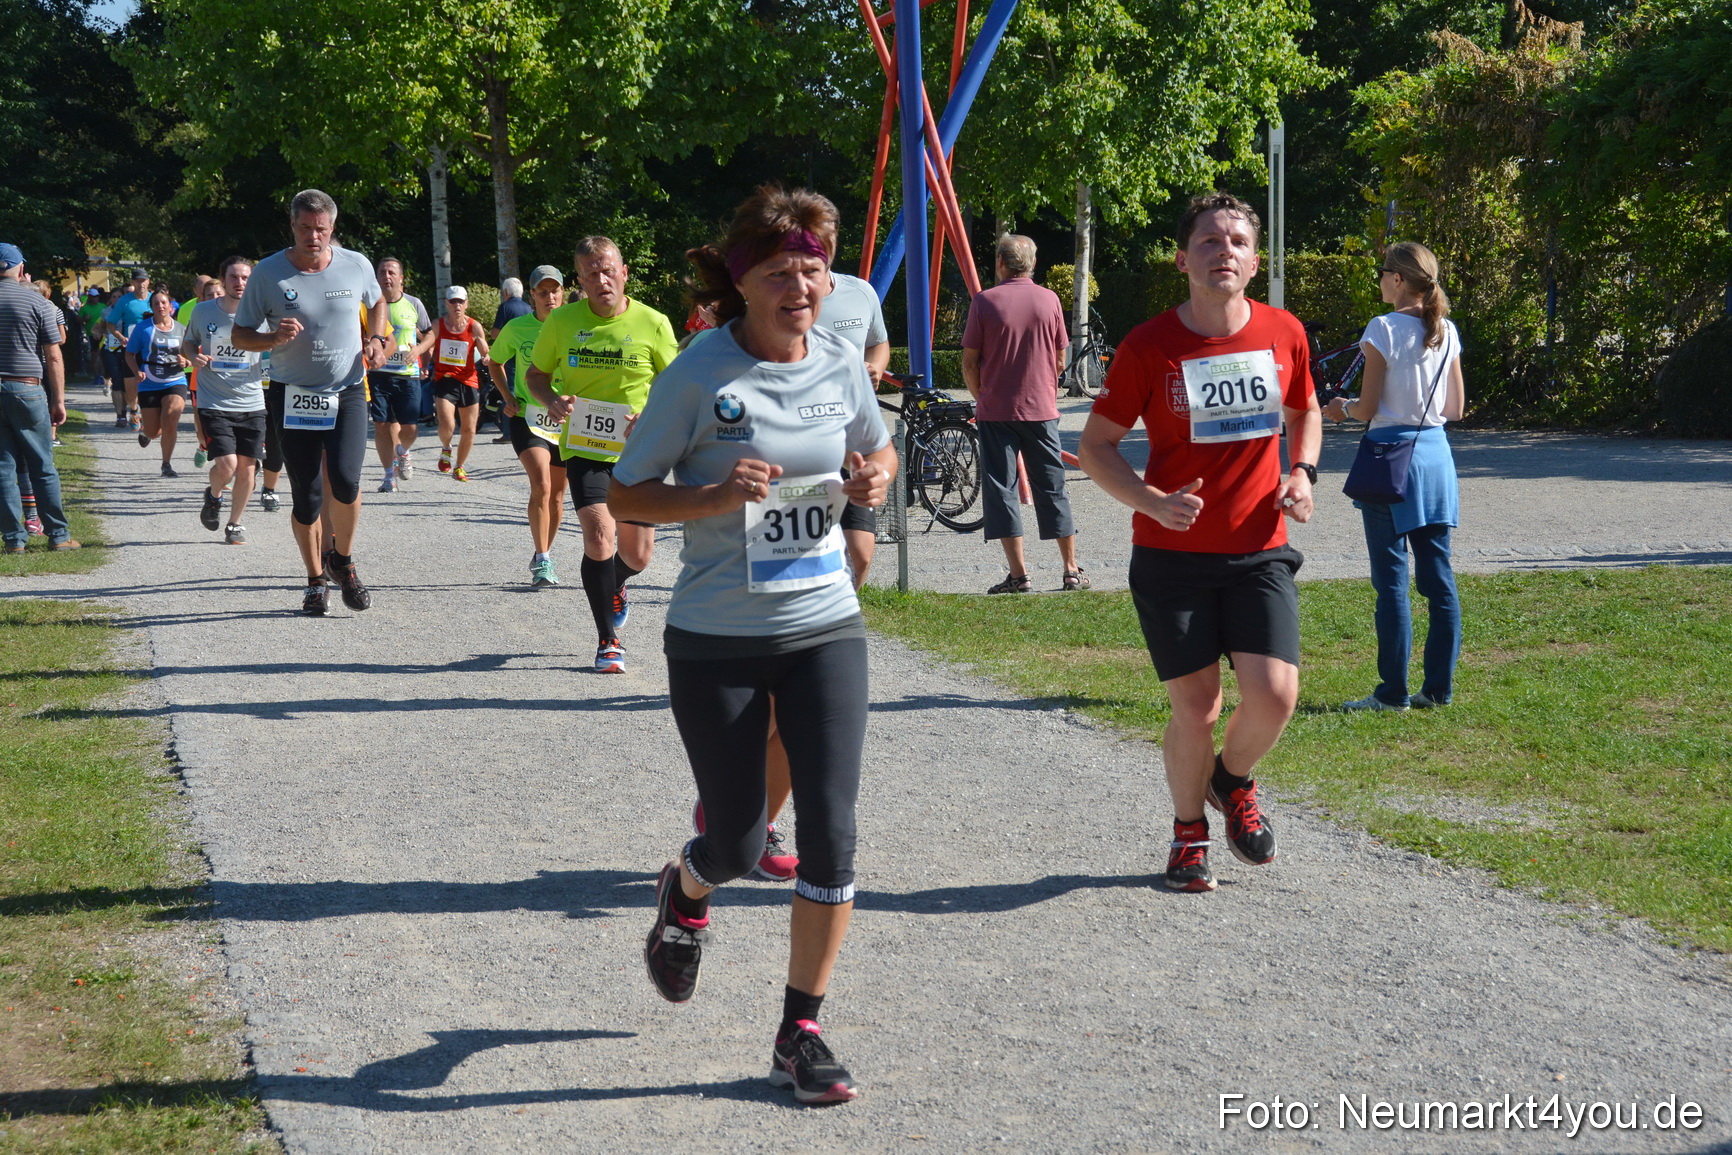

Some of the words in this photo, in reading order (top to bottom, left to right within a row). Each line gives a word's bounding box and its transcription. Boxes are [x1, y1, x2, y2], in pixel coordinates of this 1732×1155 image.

[325, 290, 353, 298] BOCK
[833, 318, 863, 329] BOCK
[312, 340, 328, 349] 19.
[217, 345, 246, 357] 2422
[449, 347, 458, 355] 31
[579, 357, 638, 366] HALBMARATHON
[1211, 361, 1250, 374] BOCK
[1201, 376, 1267, 408] 2016
[292, 394, 330, 410] 2595
[588, 404, 614, 414] BOCK
[798, 402, 846, 419] BOCK
[1230, 407, 1256, 415] Neumarkt
[585, 414, 616, 434] 159
[1220, 420, 1255, 433] Martin
[717, 427, 749, 436] PARTL
[587, 440, 607, 449] Franz
[779, 485, 828, 498] BOCK
[764, 504, 833, 542] 3105
[773, 547, 797, 555] PARTL
